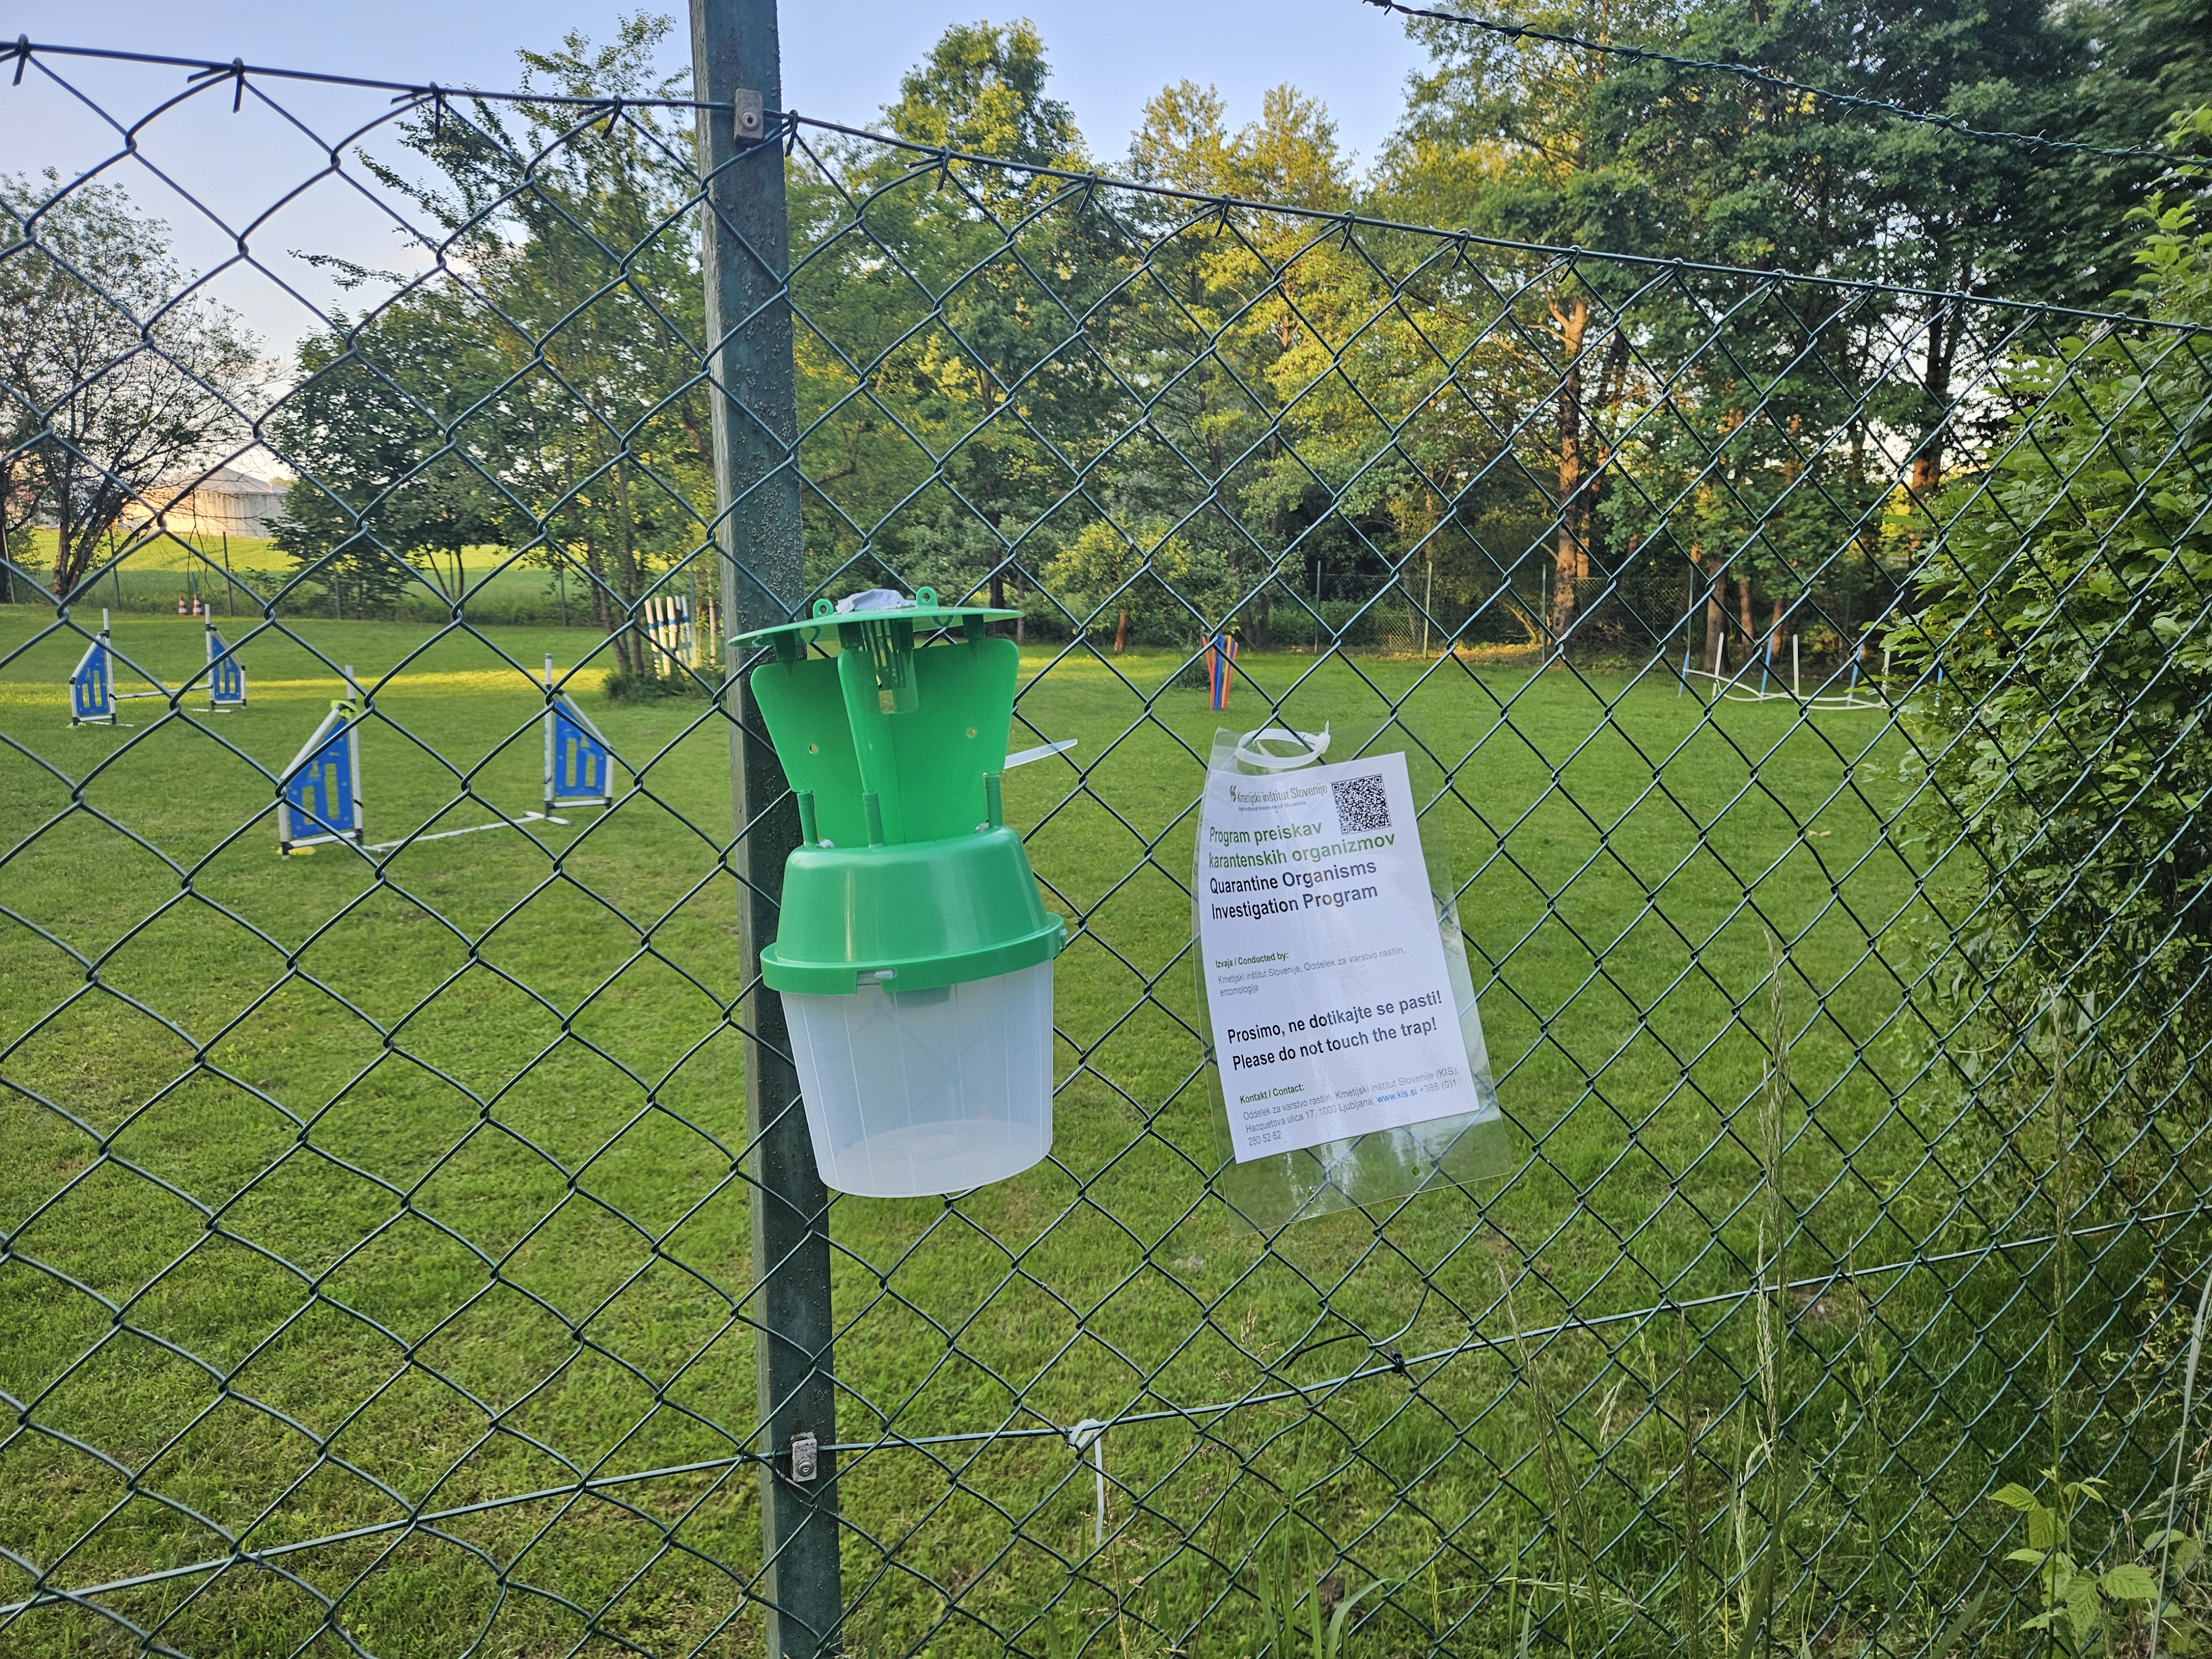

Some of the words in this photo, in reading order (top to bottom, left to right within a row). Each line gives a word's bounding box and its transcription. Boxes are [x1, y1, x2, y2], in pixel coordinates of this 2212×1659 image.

[1238, 791, 1261, 805] Kmetijski
[1262, 790, 1290, 802] inštitut
[1290, 783, 1327, 799] Slovenije
[1209, 826, 1250, 847] Program
[1254, 823, 1322, 846] preiskav
[1209, 849, 1287, 868] karantenskih
[1292, 833, 1395, 863] organizmov
[1210, 875, 1279, 895] Quarantine
[1282, 862, 1377, 888] Organisms
[1212, 898, 1299, 920] Investigation
[1302, 886, 1378, 907] Program
[1215, 958, 1233, 968] Izvaja
[1238, 953, 1275, 965] Conducted
[1277, 952, 1289, 961] by:
[1218, 972, 1244, 984] Kmetijski
[1245, 970, 1267, 980] inštitut
[1268, 965, 1302, 977] Slovenije,
[1304, 959, 1336, 971] Oddelek
[1348, 952, 1377, 963] varstvo
[1379, 947, 1406, 958] rastlin,
[1220, 984, 1259, 997] entomologija
[1228, 1024, 1285, 1044] Prosimo,
[1288, 1020, 1305, 1032] ne
[1310, 1006, 1372, 1028] dotikajte
[1376, 1003, 1394, 1015] se
[1399, 990, 1442, 1015] pasti!
[1233, 1052, 1275, 1071] Please
[1279, 1046, 1296, 1061] do
[1300, 1040, 1323, 1057] not
[1326, 1031, 1369, 1052] touch
[1372, 1027, 1397, 1042] the
[1400, 1016, 1437, 1036] trap!
[1240, 1090, 1267, 1104] Kontakt
[1272, 1084, 1305, 1097] Contact:
[1243, 1107, 1271, 1120] Oddelek
[1282, 1100, 1308, 1111] varstvo
[1335, 1084, 1369, 1099] Kmetijski
[1371, 1079, 1397, 1092] inštitut
[1398, 1072, 1434, 1086] Slovenije
[1246, 1118, 1286, 1133] Hacquetova
[1287, 1114, 1303, 1124] ulica
[1319, 1105, 1337, 1116] 1000
[1376, 1087, 1417, 1103] www.kis.si
[1420, 1082, 1439, 1093] +386
[1442, 1079, 1457, 1091] (0)1
[1248, 1135, 1261, 1146] 280
[1263, 1133, 1271, 1143] 52
[1273, 1130, 1282, 1140] 62
